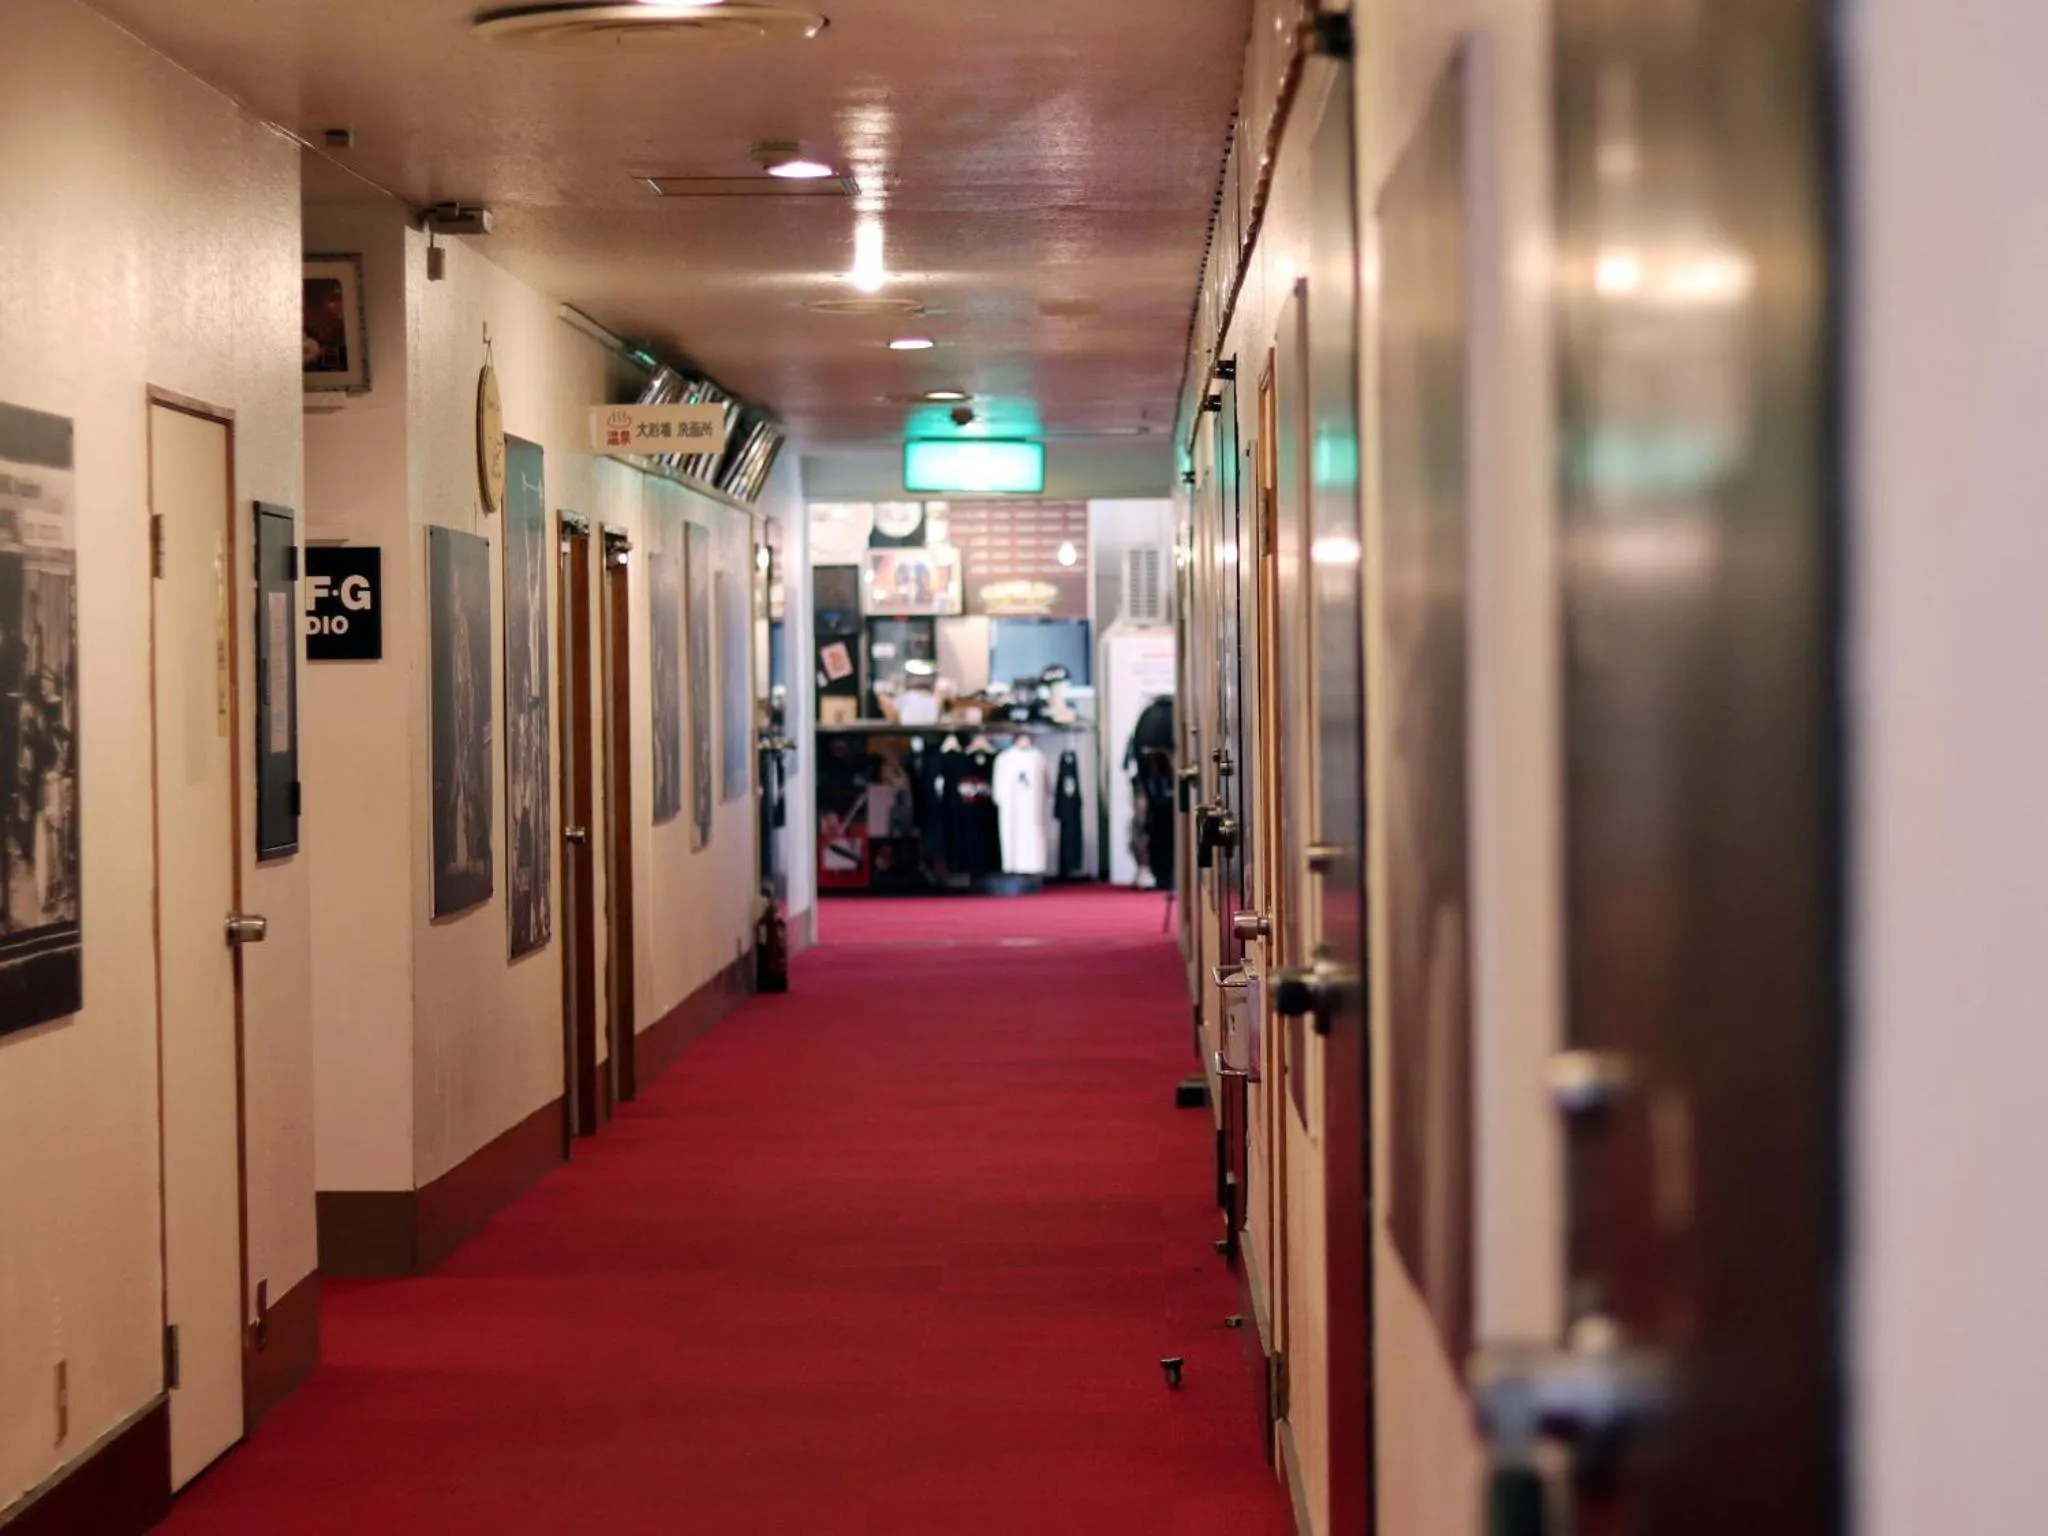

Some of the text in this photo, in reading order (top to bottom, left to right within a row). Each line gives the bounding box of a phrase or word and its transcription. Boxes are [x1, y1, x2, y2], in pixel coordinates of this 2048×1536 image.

[637, 420, 671, 438] 大浴場
[306, 615, 349, 635] DIO
